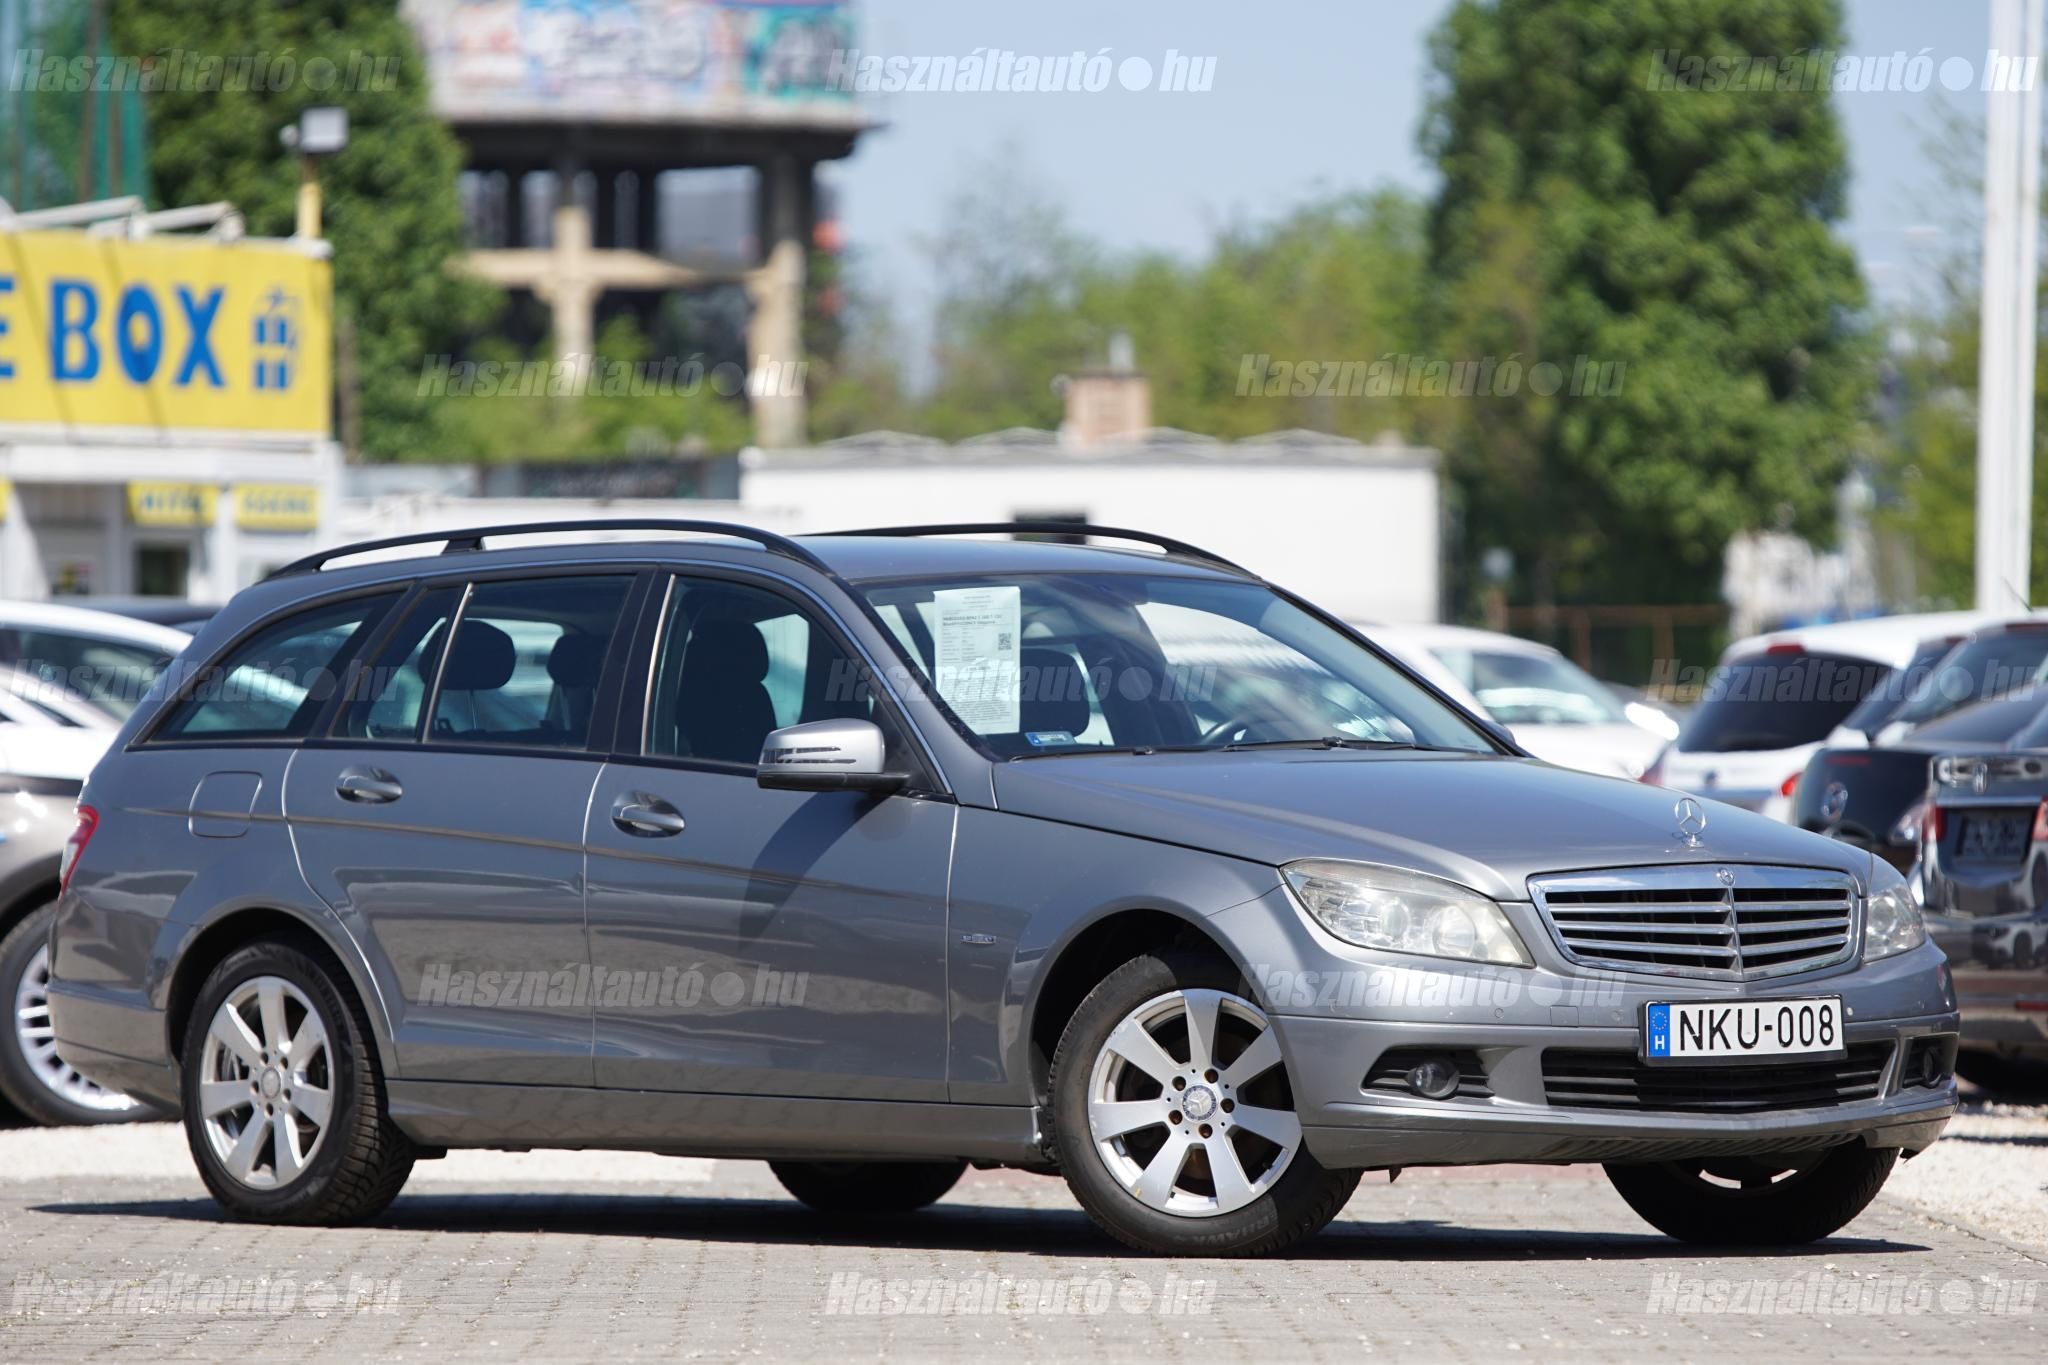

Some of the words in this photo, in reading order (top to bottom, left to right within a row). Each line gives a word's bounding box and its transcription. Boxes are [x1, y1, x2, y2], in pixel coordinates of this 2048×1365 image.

[51, 277, 226, 388] BOX
[1654, 1035, 1665, 1050] H
[1679, 1004, 1835, 1051] NKU-008
